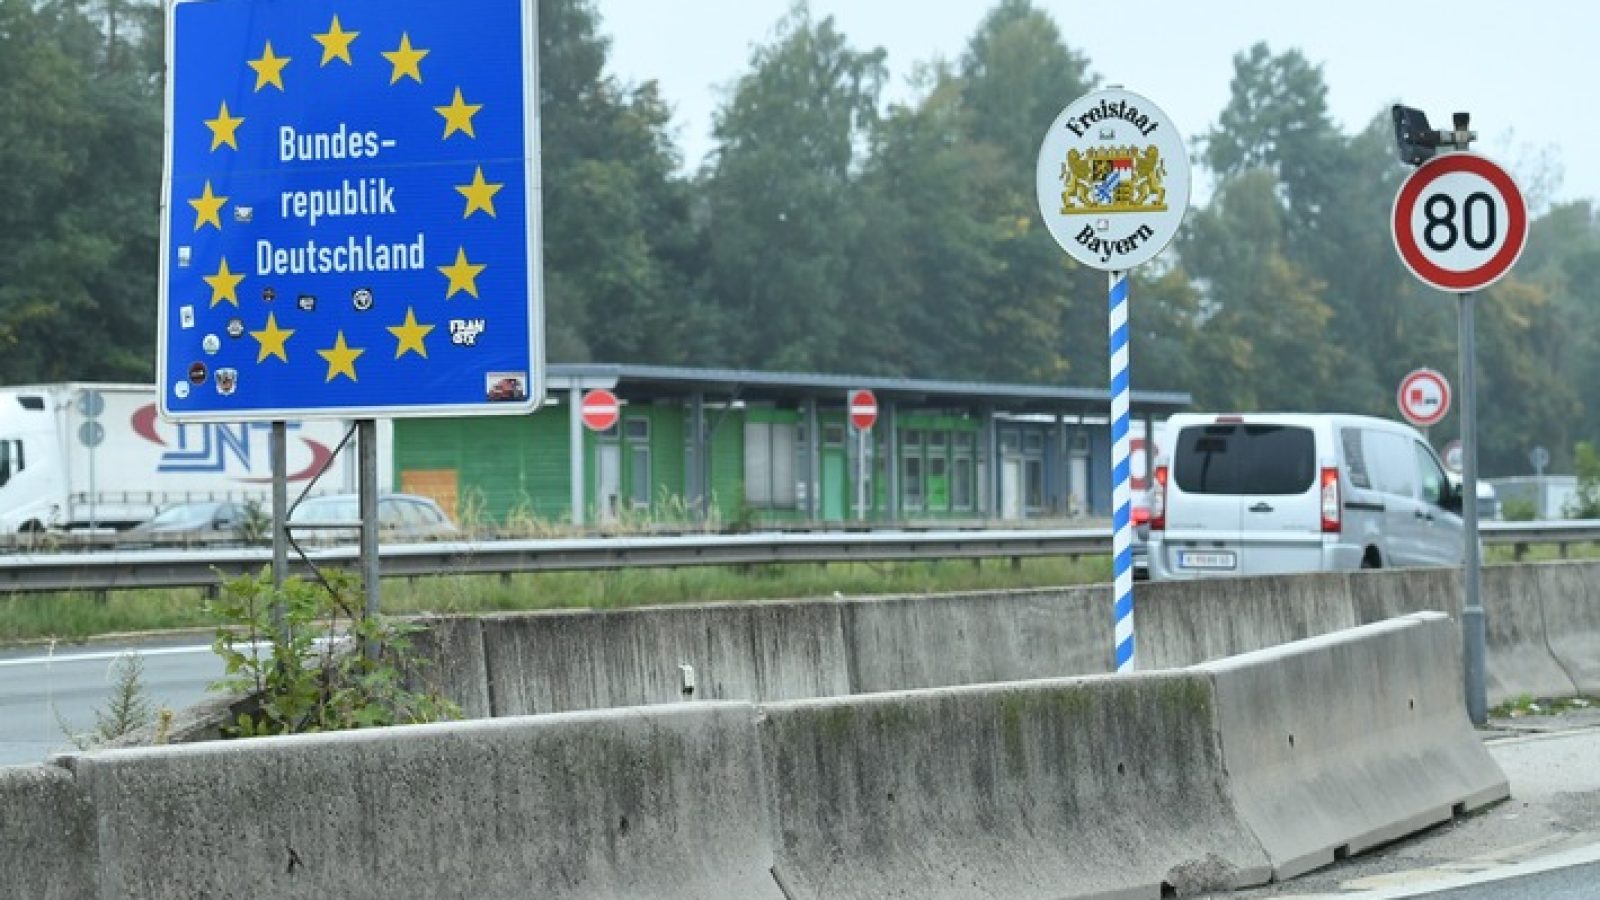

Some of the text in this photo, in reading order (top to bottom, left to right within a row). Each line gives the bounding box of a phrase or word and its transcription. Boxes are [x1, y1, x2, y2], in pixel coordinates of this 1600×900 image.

[1066, 99, 1159, 138] Freistaat
[279, 123, 397, 161] Bundes-
[281, 177, 397, 226] republik
[1424, 191, 1497, 252] 80
[256, 233, 425, 275] Deutschland
[1075, 223, 1154, 262] Bayern
